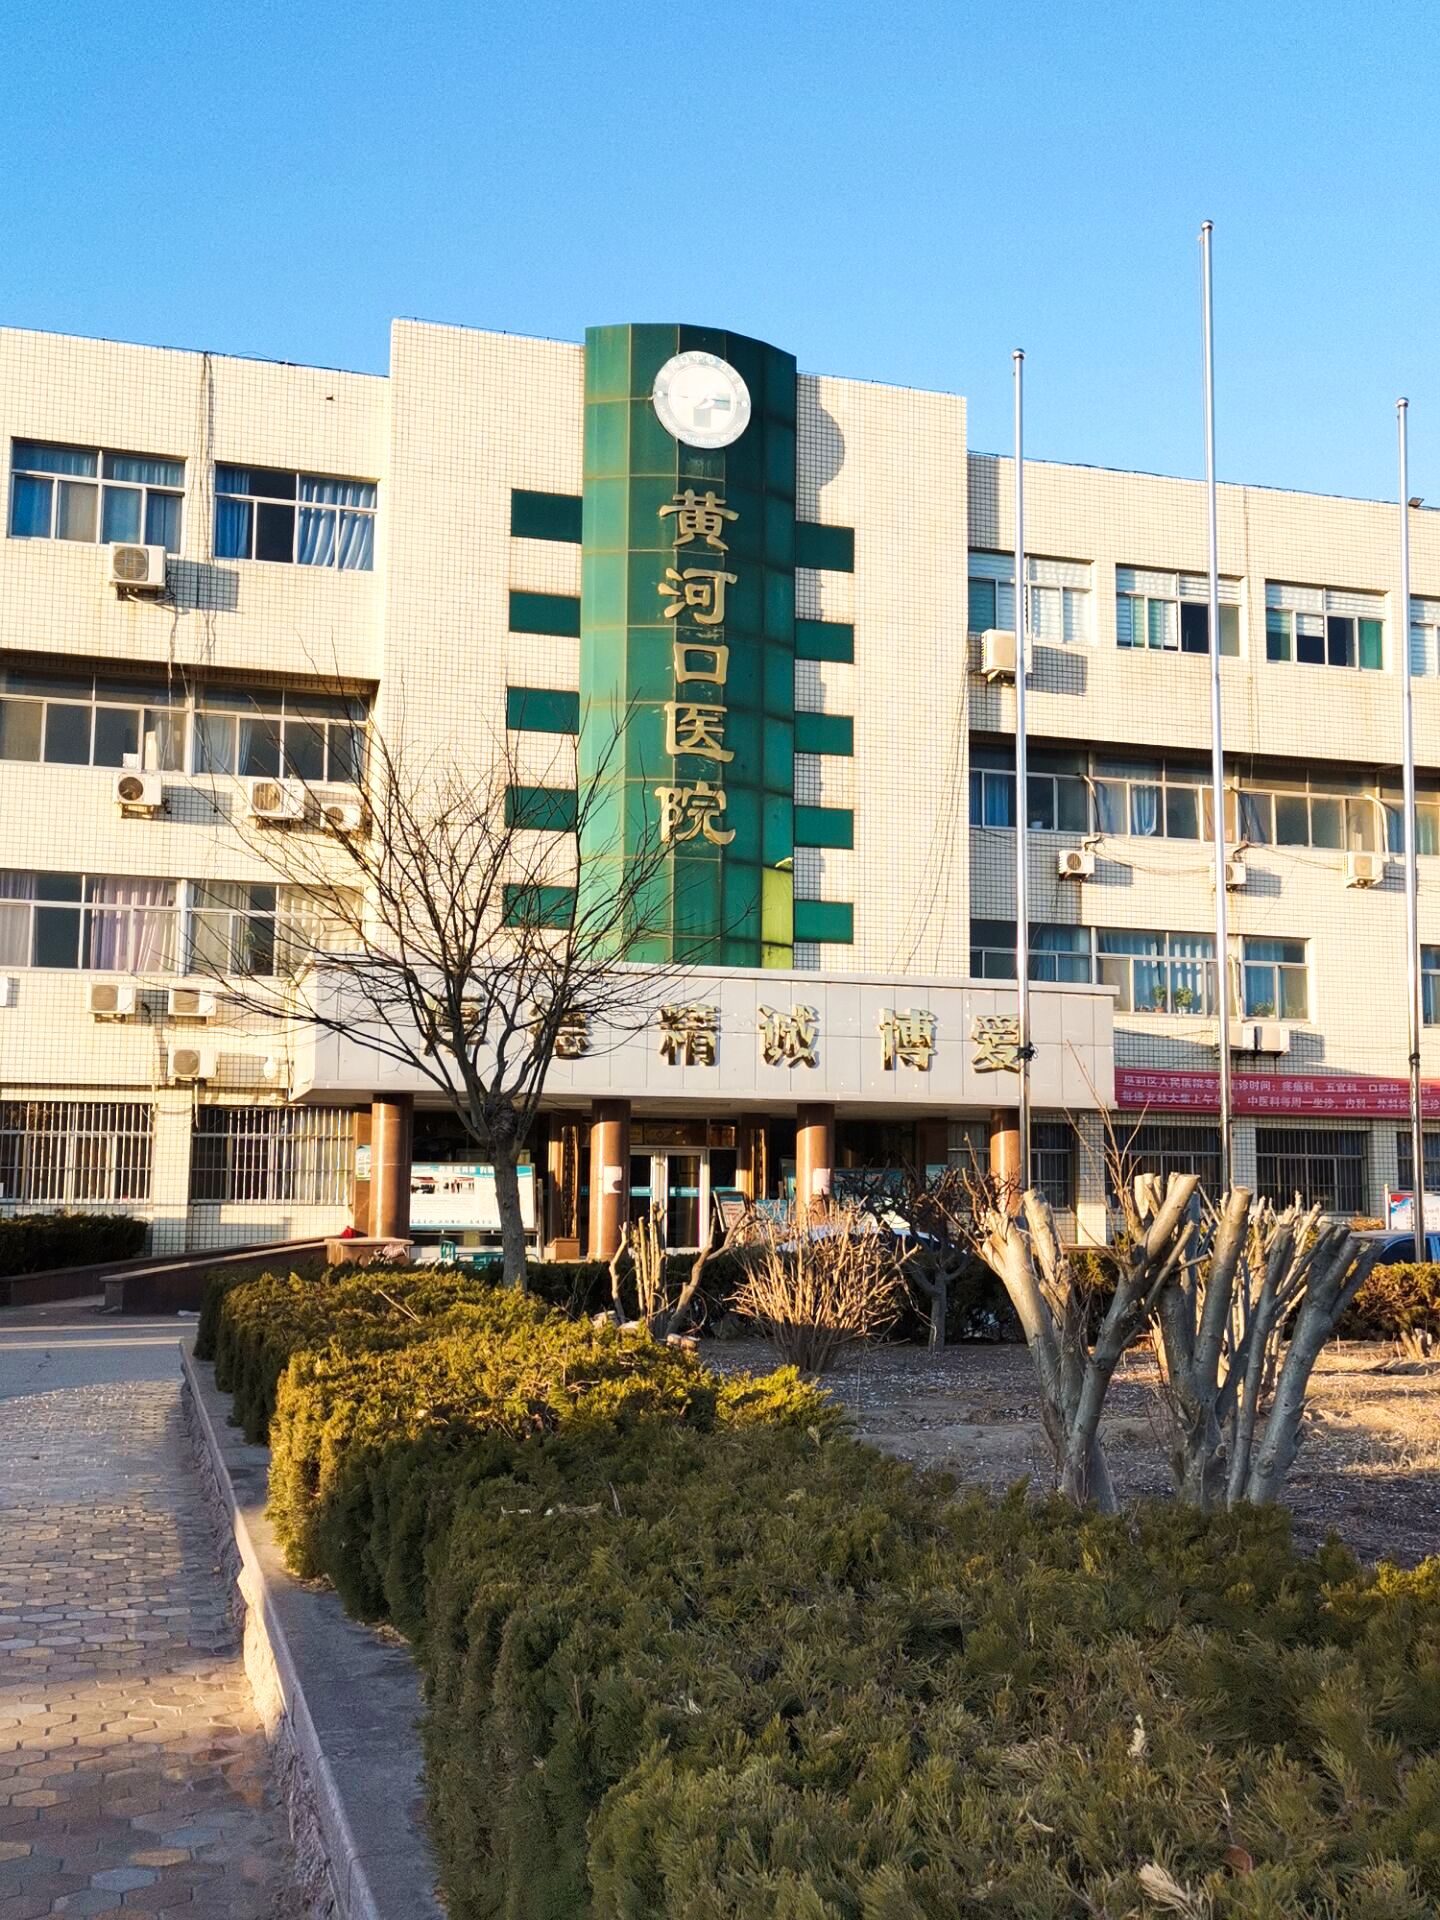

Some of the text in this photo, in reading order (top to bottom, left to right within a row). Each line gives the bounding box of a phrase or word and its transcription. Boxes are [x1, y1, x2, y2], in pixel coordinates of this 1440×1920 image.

[655, 488, 740, 846] 黄河口医院
